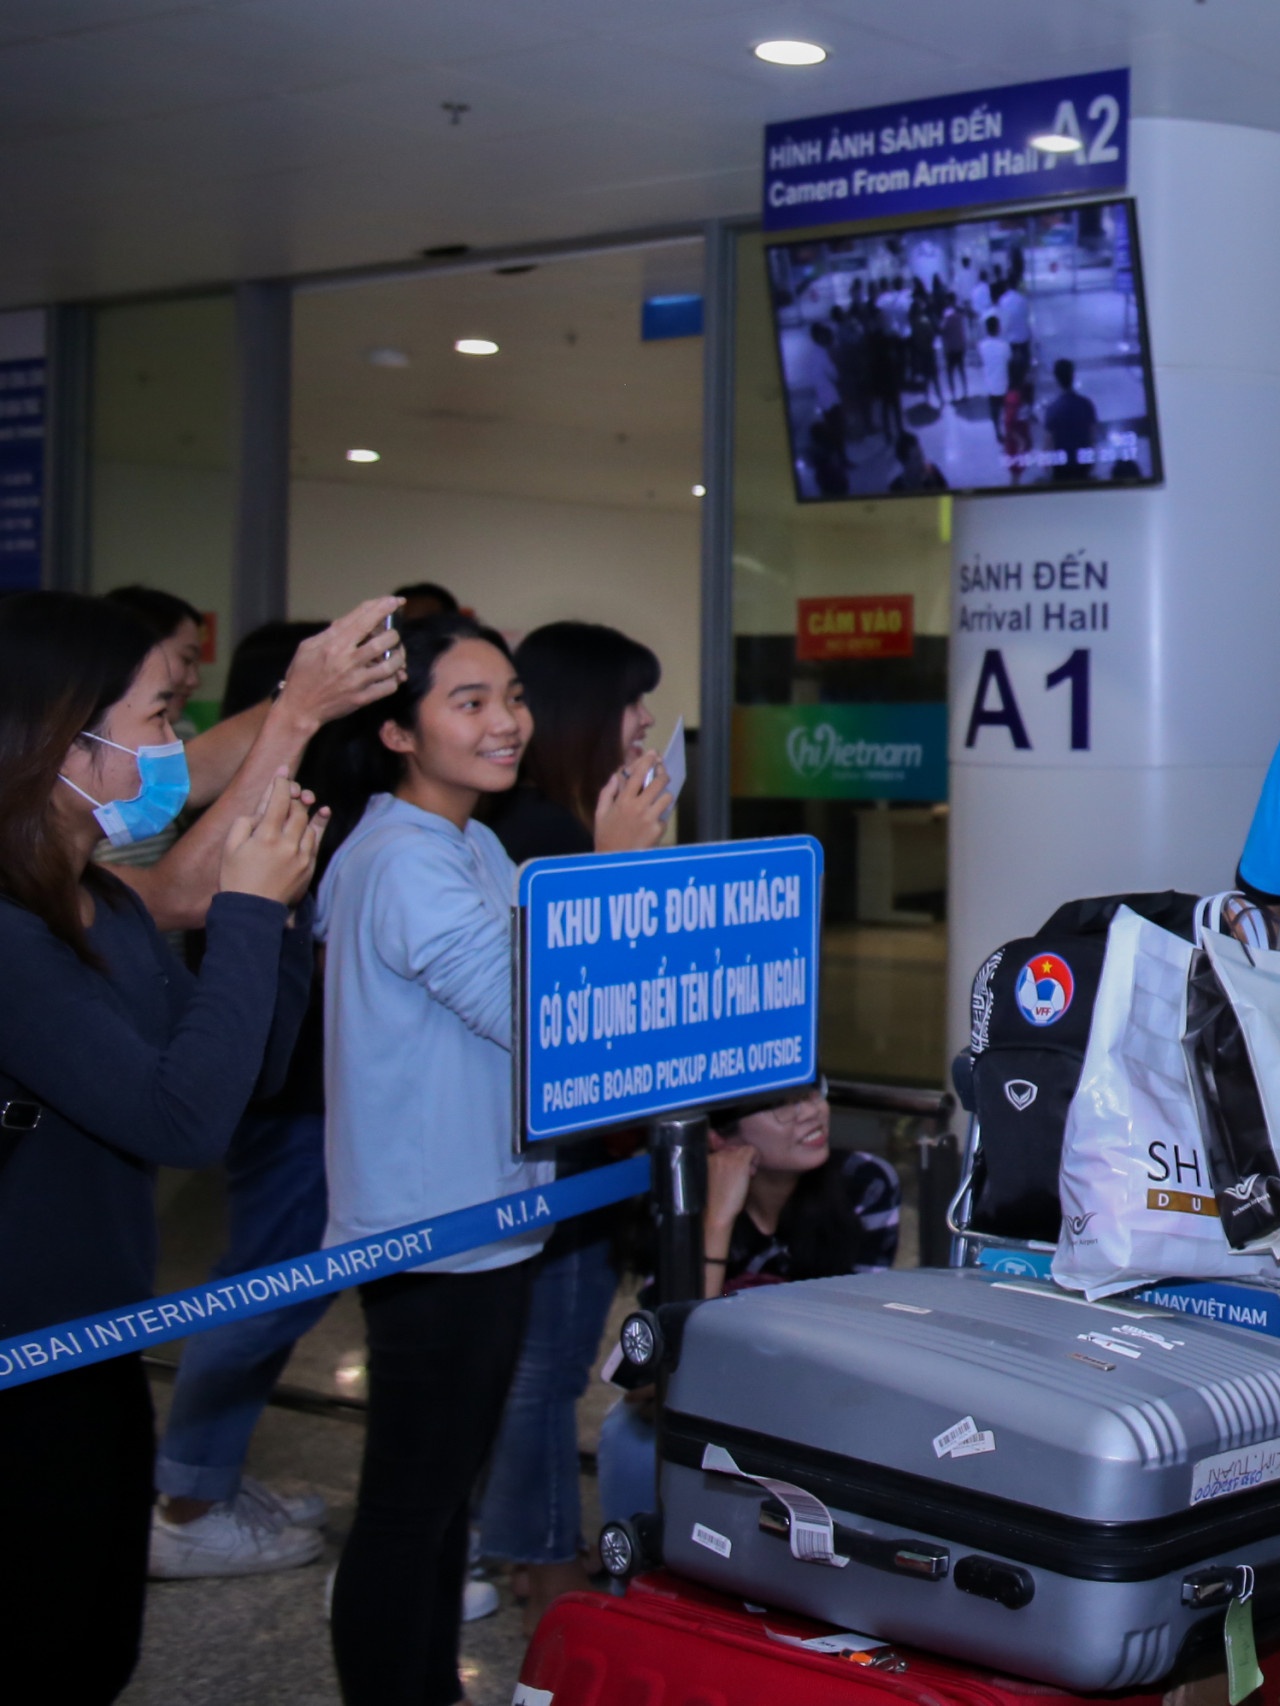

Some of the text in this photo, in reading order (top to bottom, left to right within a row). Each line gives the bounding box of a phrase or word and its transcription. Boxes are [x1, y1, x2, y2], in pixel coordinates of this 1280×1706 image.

[769, 103, 1002, 170] HÌNH ẢNH SẢNH ĐẾN
[1044, 94, 1120, 170] A2
[769, 150, 1038, 207] Camera From Arrival Hall
[960, 548, 1107, 593] SẢNH ĐẾN
[958, 602, 1109, 632] Arrival Hall
[965, 648, 1090, 750] A1
[547, 869, 801, 949] KHU VỰC ĐÓN KHÁCH
[539, 947, 806, 1050] CÓ SỬ DỤNG BIỂN TÊN Ở PHÍA NGOÀI
[1035, 1006, 1052, 1016] VFF
[543, 1035, 802, 1114] PAGING BOARD PICKUP AREA OUTSIDE
[84, 1264, 325, 1349] INTERNATIONAL
[327, 1228, 433, 1281] AIRPORT
[496, 1194, 551, 1231] N.I.A
[1155, 1291, 1191, 1314] MAY
[1191, 1298, 1228, 1321] VIỆT
[1228, 1303, 1268, 1327] NAM
